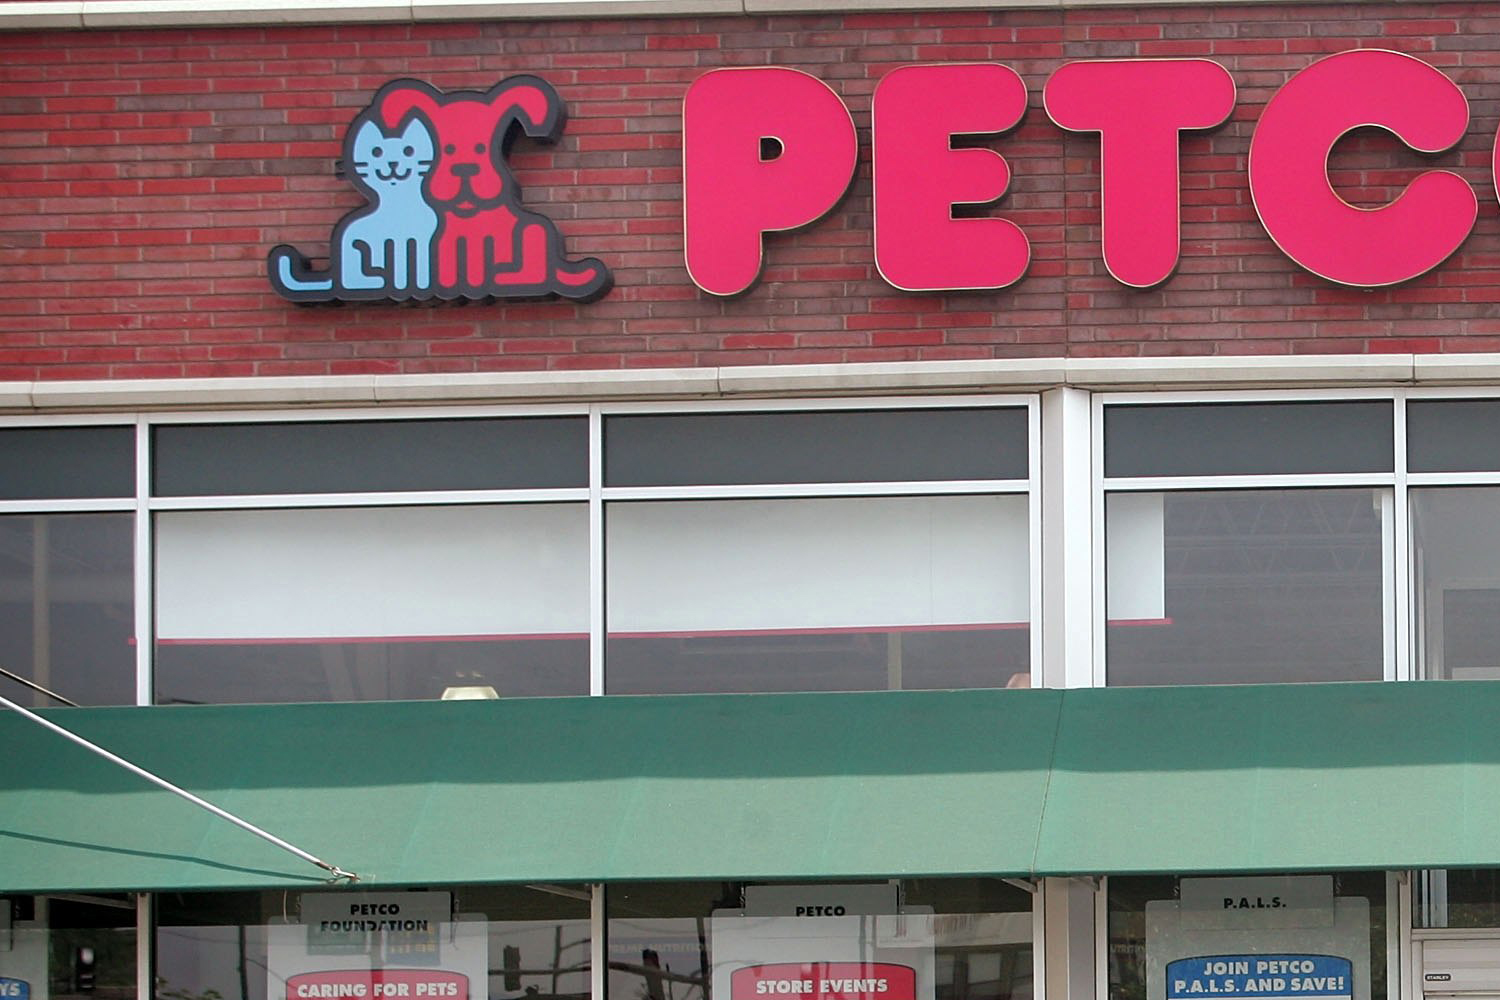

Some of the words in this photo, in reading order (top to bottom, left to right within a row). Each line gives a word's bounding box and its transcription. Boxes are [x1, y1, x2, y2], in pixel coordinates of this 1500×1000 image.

[350, 903, 400, 916] PETCO
[1223, 897, 1287, 909] P.A.L.S.
[795, 905, 846, 917] PETCO
[320, 920, 428, 932] FOUNDATION
[1204, 961, 1249, 976] JOIN
[1256, 960, 1315, 974] PETCO
[297, 984, 367, 998] CARING
[373, 983, 409, 997] FOR
[416, 982, 457, 996] PETS
[756, 979, 813, 994] STORE
[820, 977, 888, 993] EVENTS
[1174, 979, 1240, 993] P.A.L.S.
[1244, 977, 1286, 992] AND
[1290, 976, 1344, 991] SAVE!
